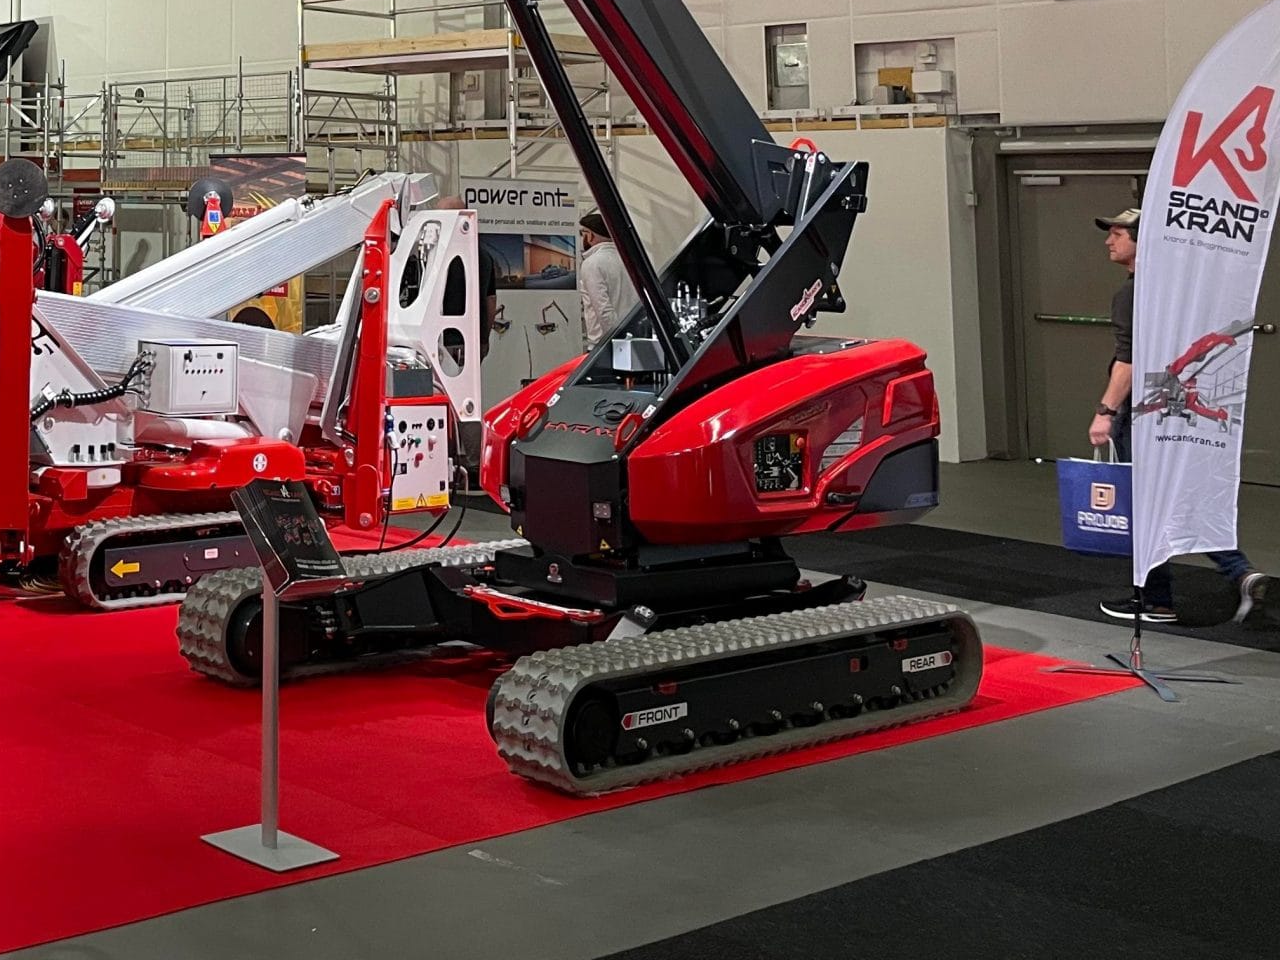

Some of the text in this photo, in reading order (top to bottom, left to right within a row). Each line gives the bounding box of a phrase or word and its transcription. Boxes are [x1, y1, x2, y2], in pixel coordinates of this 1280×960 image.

[465, 187, 569, 209] power ant
[1166, 208, 1255, 243] KRAN
[1077, 511, 1129, 530] PROJOB
[909, 656, 937, 670] REAR
[638, 705, 681, 724] FRONT
